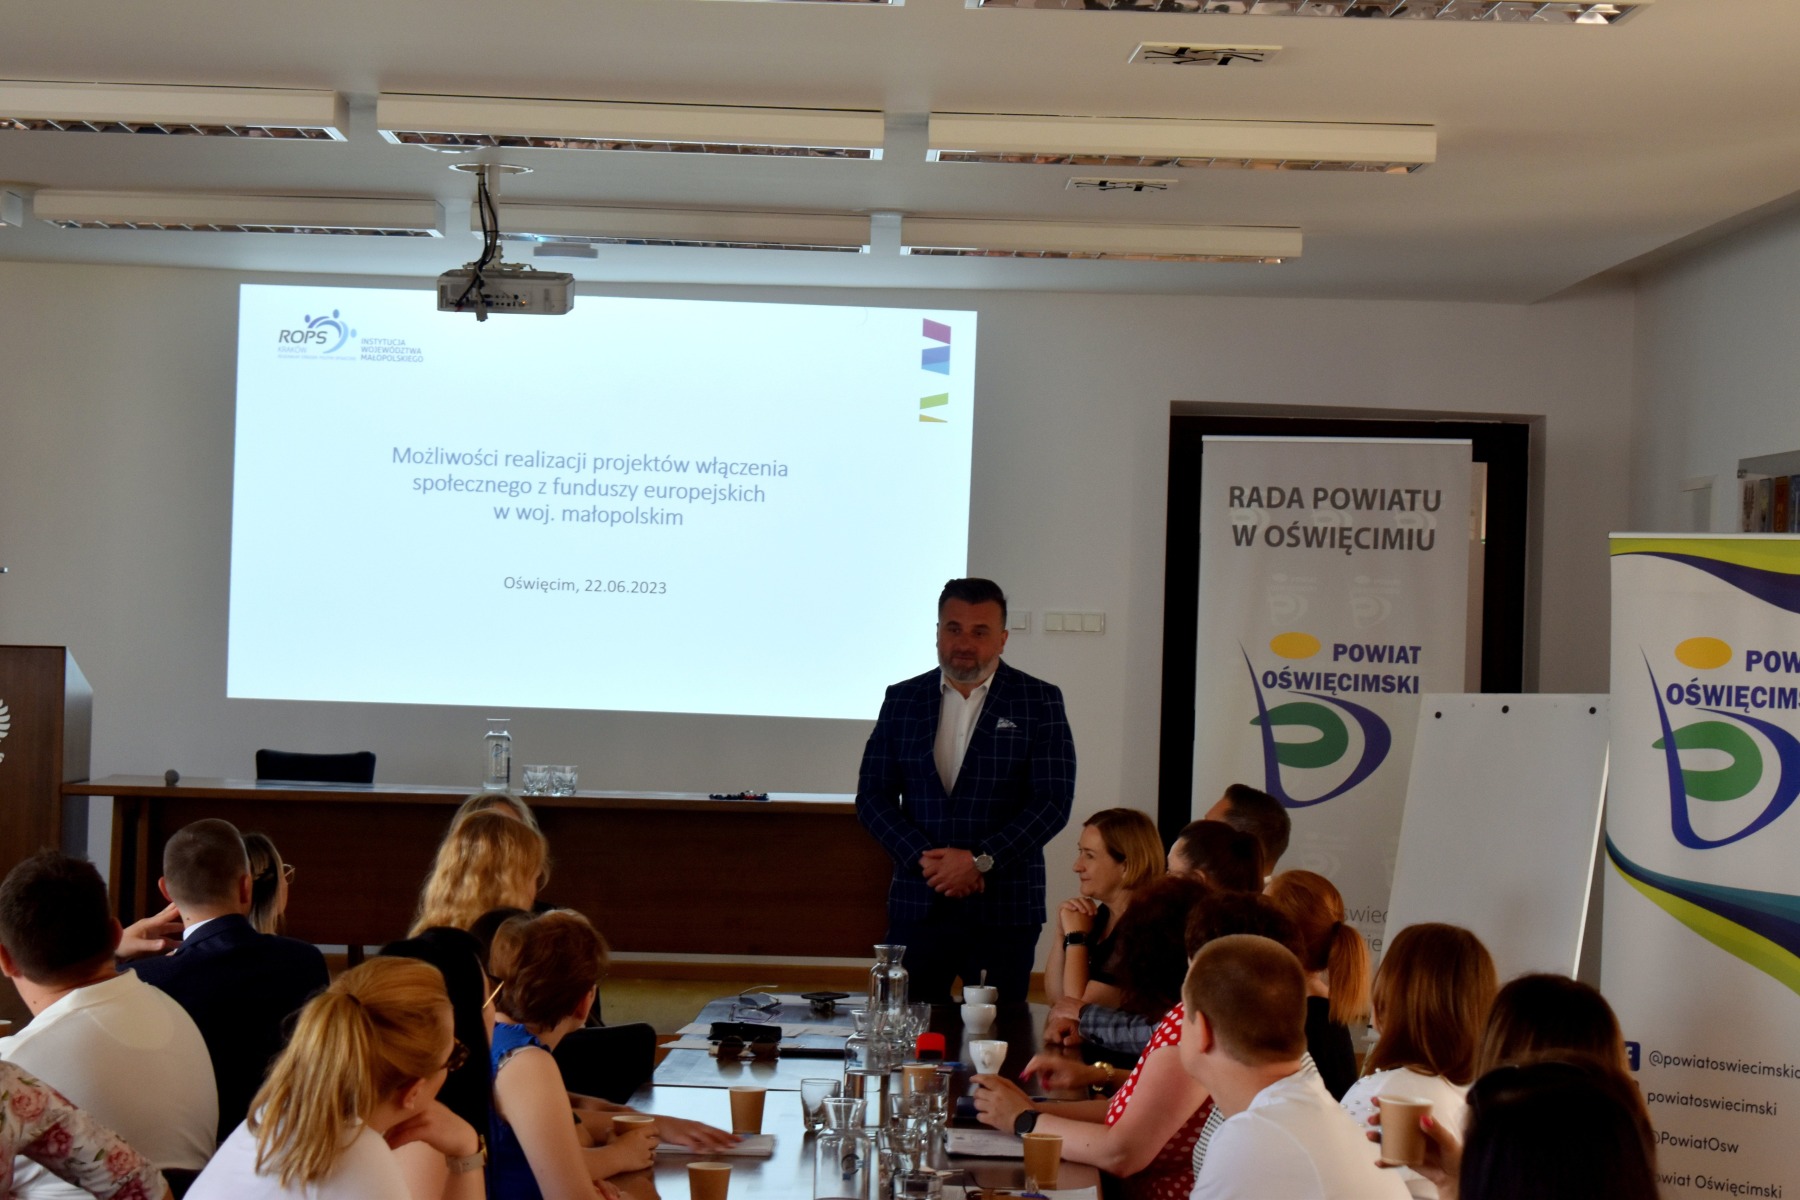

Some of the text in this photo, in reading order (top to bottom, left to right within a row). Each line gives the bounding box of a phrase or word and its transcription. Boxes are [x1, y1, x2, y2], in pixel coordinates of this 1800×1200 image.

[278, 329, 328, 345] ROPS
[361, 338, 406, 346] INSTYTUCJA
[360, 346, 422, 354] WOJEWÓDZTWA
[360, 354, 424, 363] MAŁOPOLSKIEGO
[392, 446, 789, 479] Możliwości realizacji projektów włączenia
[412, 473, 766, 505] społecznego z funduszy europejskich
[1229, 485, 1442, 512] RADA POWIATU
[493, 505, 684, 527] w woj. małopolskim
[1232, 521, 1435, 556] W OŚWIĘCIMIU
[503, 576, 667, 595] Oświęcim, 22.06.2023
[1333, 643, 1422, 665] POWIAT
[1262, 666, 1420, 696] OŚWIĘCIMSKI
[1666, 677, 1800, 713] OŚWIĘCIM
[1647, 1091, 1777, 1116] powiatoswiecimski
[1655, 1171, 1782, 1199] owiat Oświęcimski
